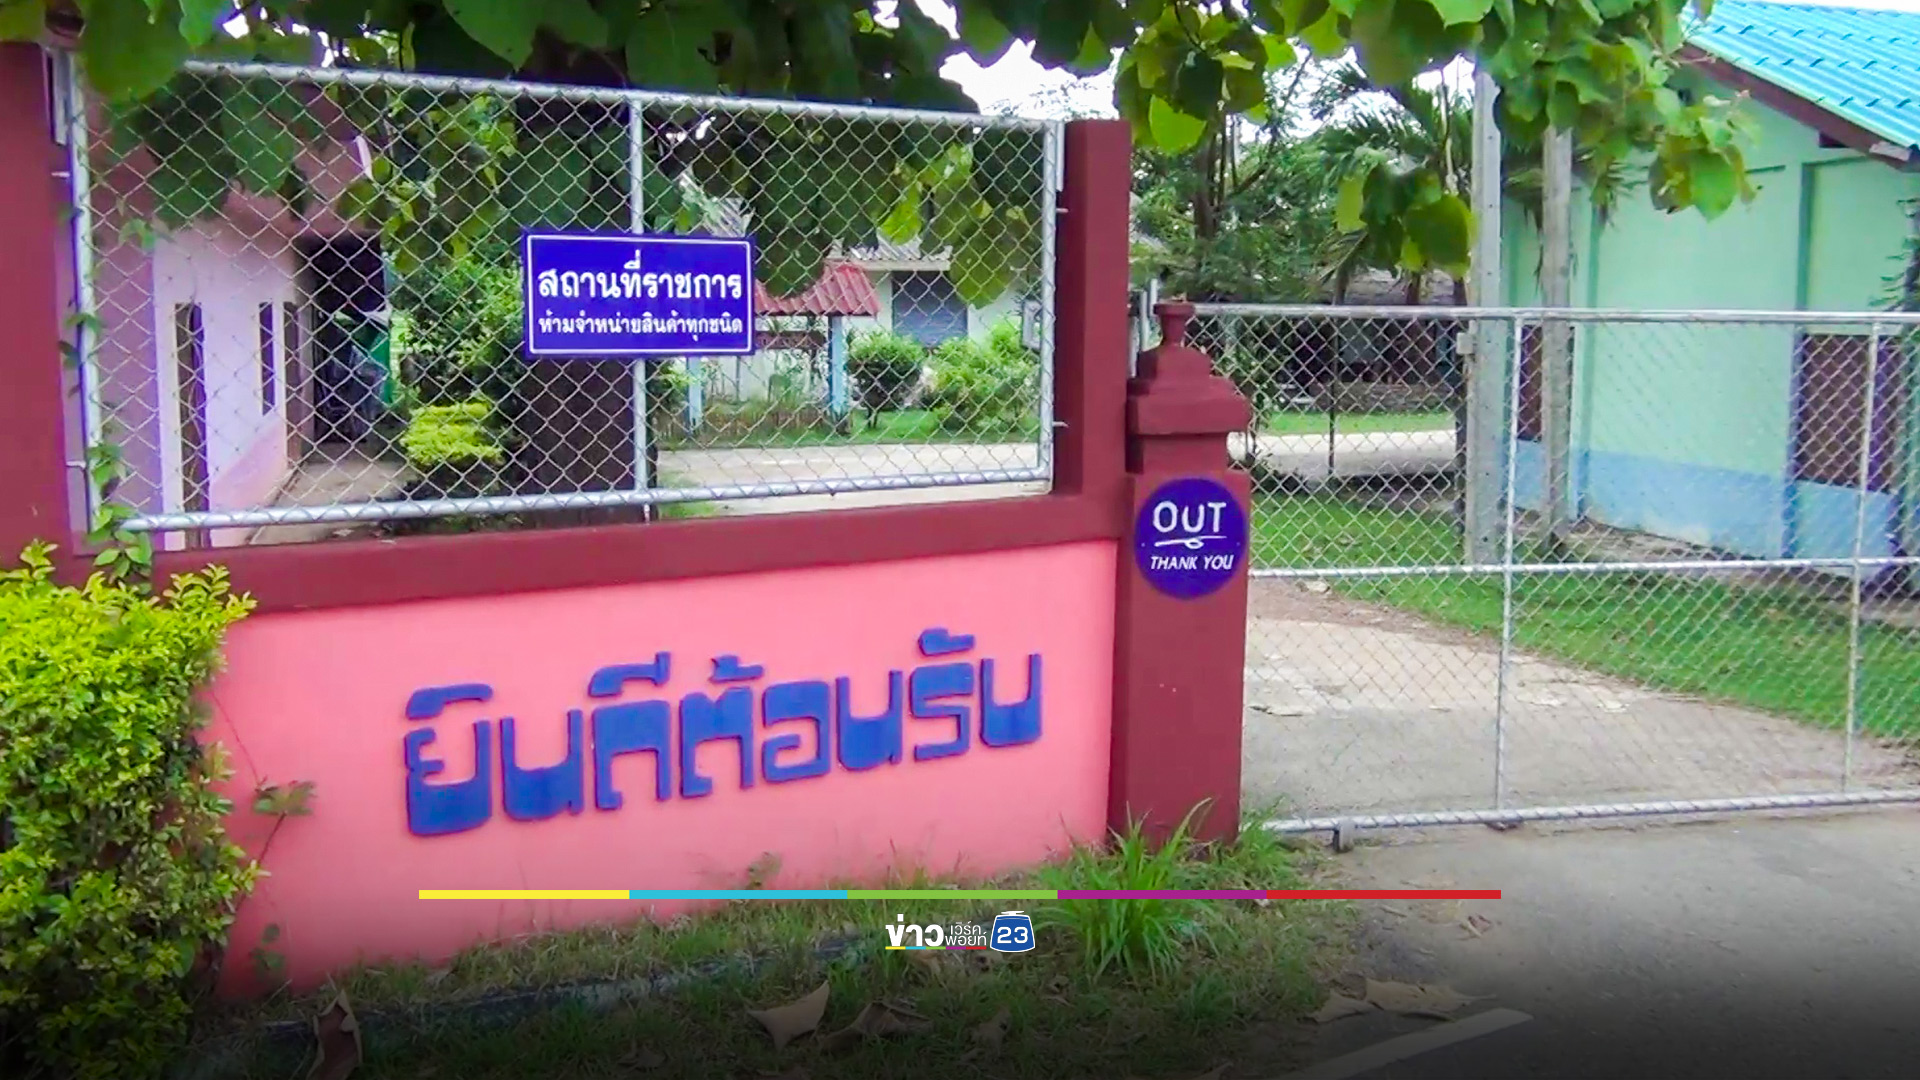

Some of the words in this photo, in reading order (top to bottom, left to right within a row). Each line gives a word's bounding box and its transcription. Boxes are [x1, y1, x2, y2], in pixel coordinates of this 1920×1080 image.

[537, 249, 743, 299] สถานที่ราชการ
[537, 309, 743, 342] ห้ามจำหน่ายสินค้าทุกชนิด
[1153, 500, 1227, 533] OUT
[1150, 556, 1198, 570] THANK
[1204, 554, 1235, 570] YOU
[404, 628, 1043, 837] ยินดีต้อนรับ
